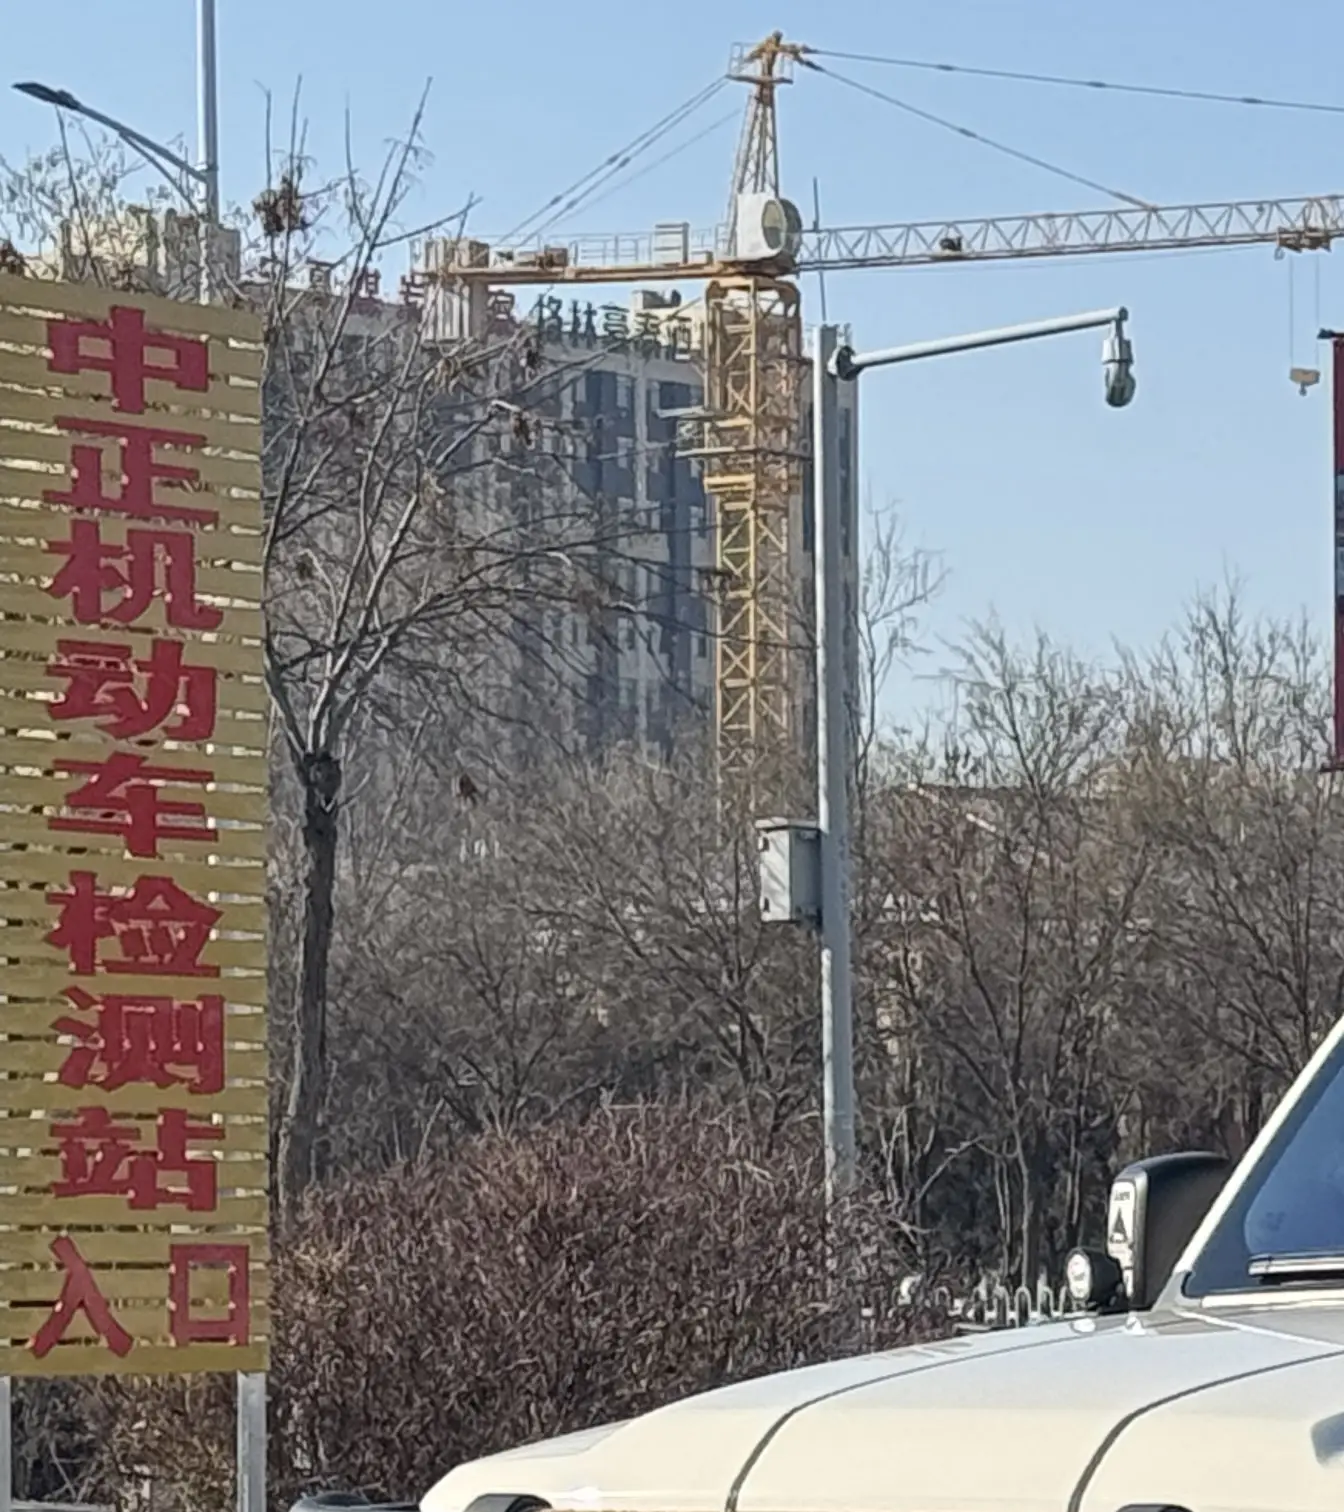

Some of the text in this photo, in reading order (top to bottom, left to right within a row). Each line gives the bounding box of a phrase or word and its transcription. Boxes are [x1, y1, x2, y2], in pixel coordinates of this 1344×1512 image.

[42, 304, 226, 1211] 中正机动车检测站
[28, 1235, 249, 1359] 入口
